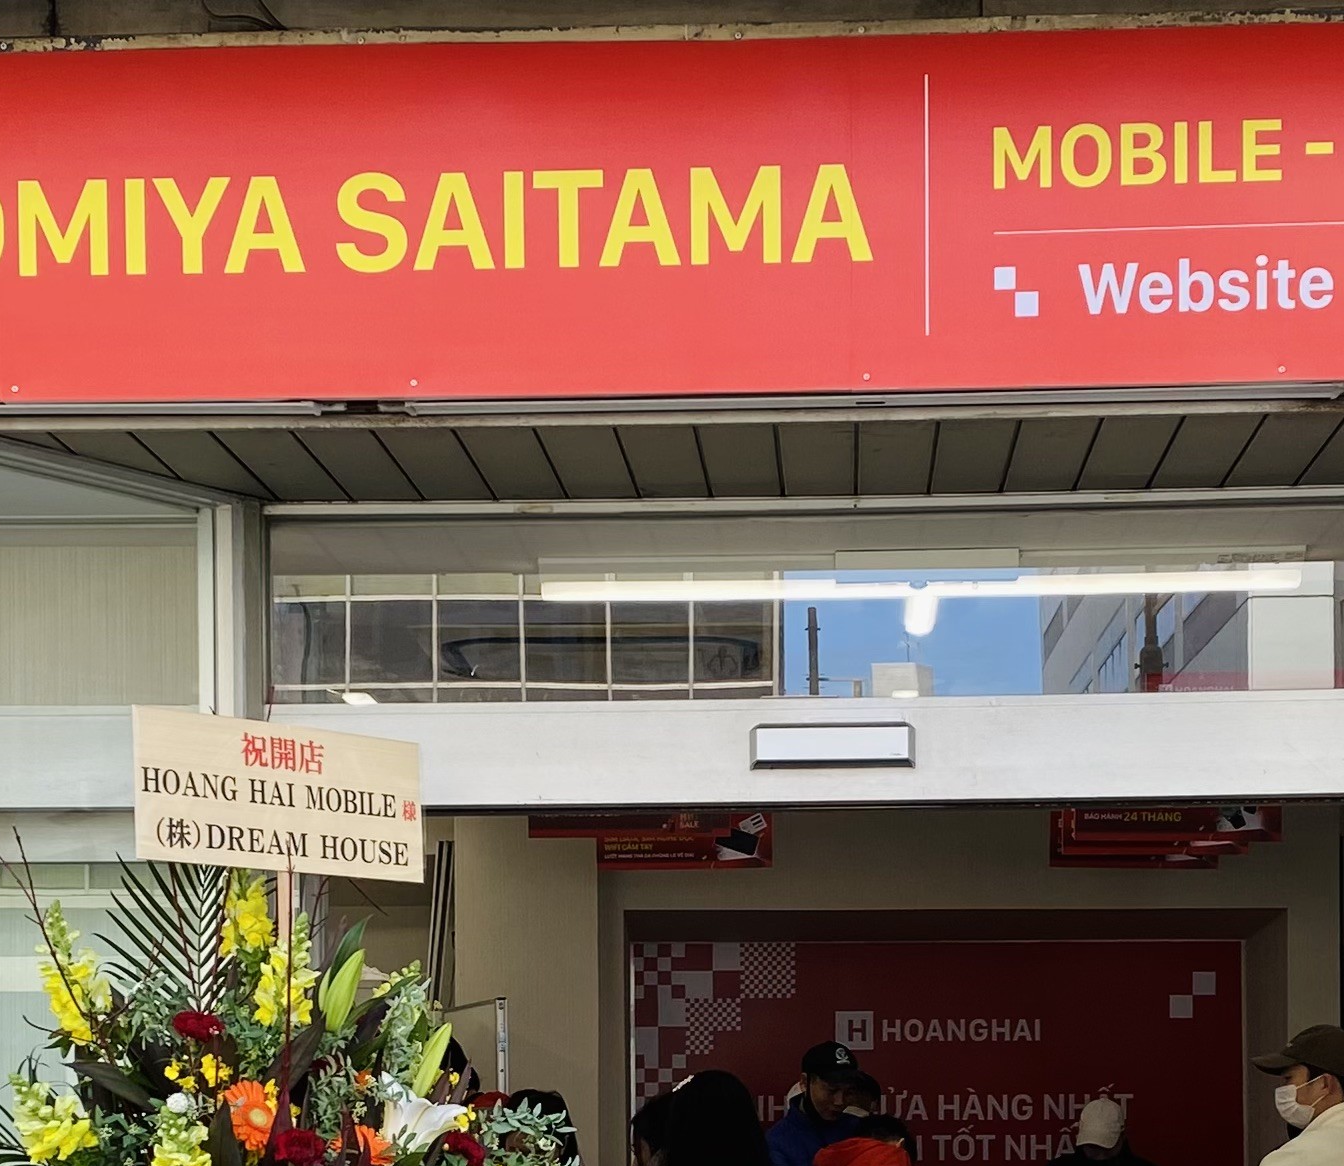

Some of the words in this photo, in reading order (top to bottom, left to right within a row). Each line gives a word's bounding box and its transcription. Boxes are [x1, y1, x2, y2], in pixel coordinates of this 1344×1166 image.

[992, 118, 1284, 189] MOBILE
[1305, 140, 1334, 156] -
[335, 165, 873, 273] SAITAMA
[1079, 254, 1334, 316] Website
[241, 732, 325, 775] 祝開店
[141, 766, 237, 802] HOANG
[248, 778, 296, 808] HAI
[305, 785, 397, 819] MOBILE
[1123, 811, 1138, 822] 24
[320, 834, 409, 867] HOUSE
[882, 1018, 1042, 1042] HOANGHAI
[937, 1087, 1033, 1121] HÀNG
[1043, 1083, 1134, 1121] NHT
[932, 1124, 996, 1162] TỐT
